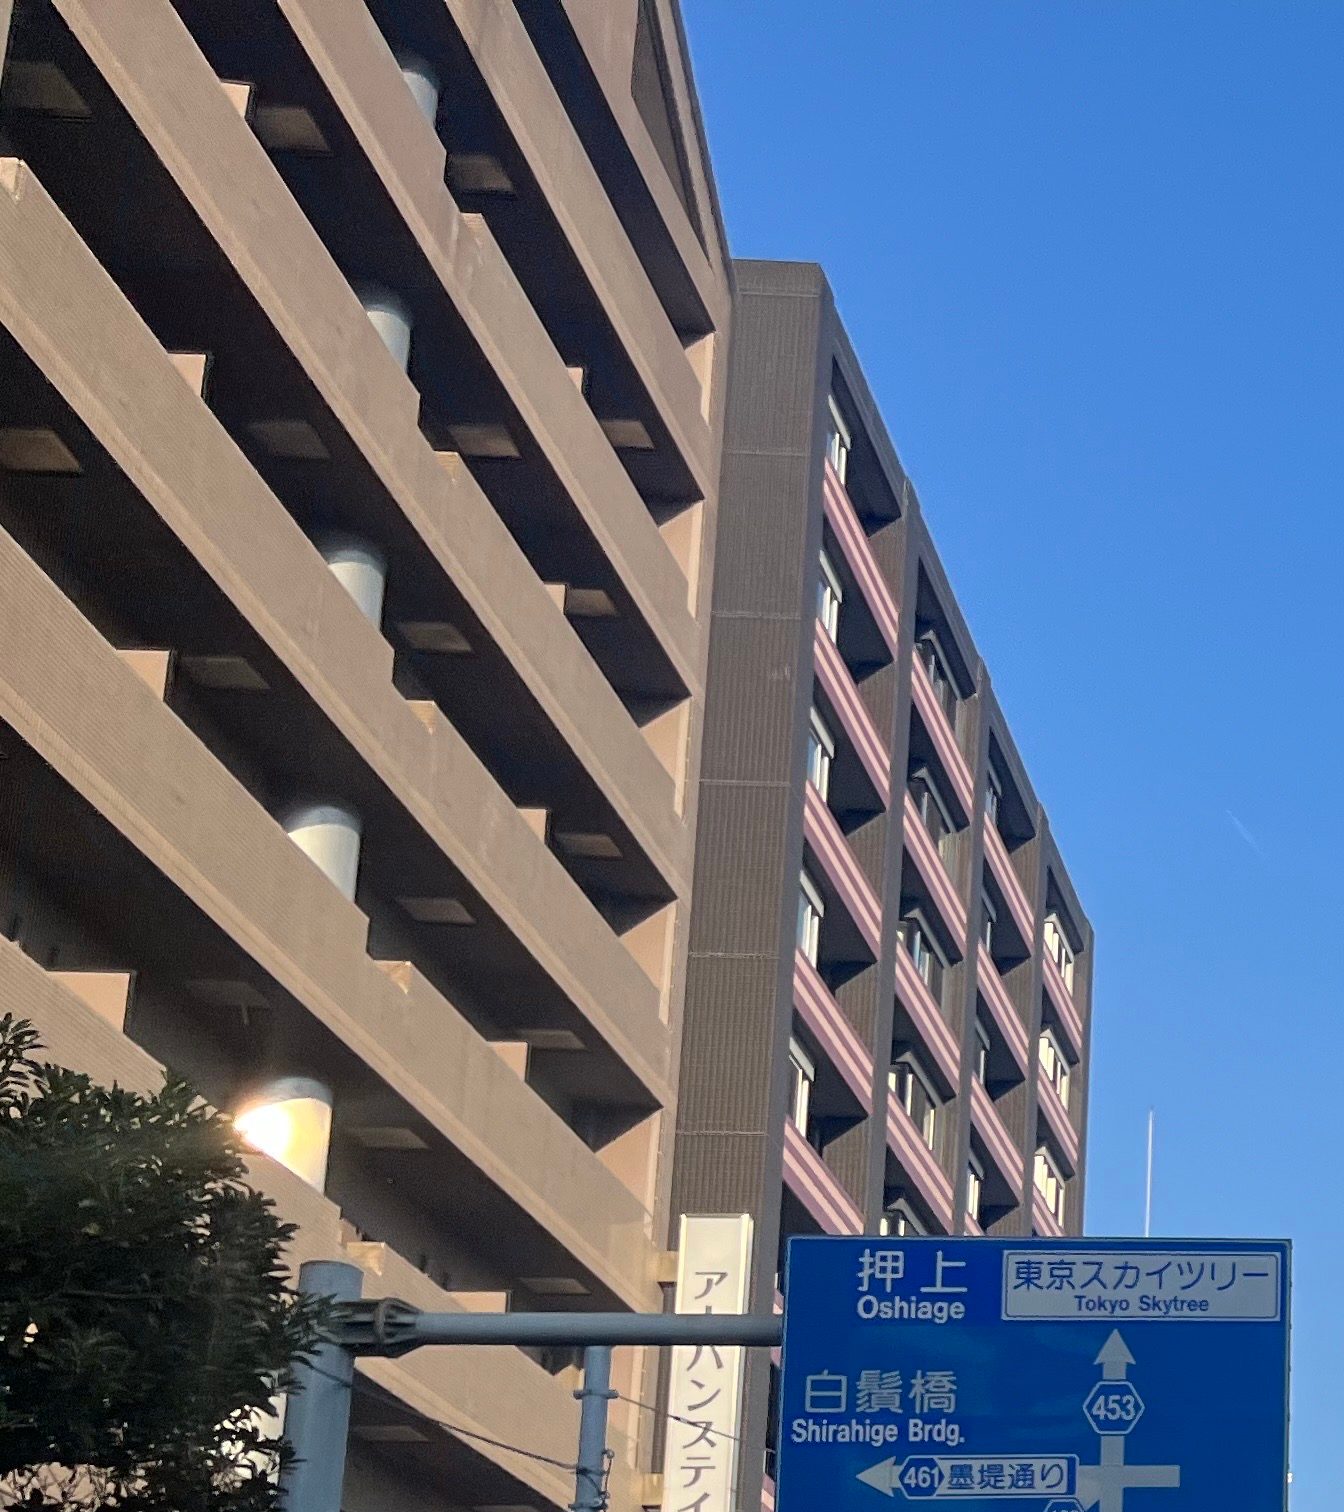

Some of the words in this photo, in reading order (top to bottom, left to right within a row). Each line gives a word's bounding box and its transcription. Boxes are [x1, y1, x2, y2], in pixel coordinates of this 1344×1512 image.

[857, 1248, 968, 1295] 押上
[1012, 1260, 1271, 1292] 東京スカイツリー
[856, 1294, 967, 1324] Oshiage
[1074, 1294, 1130, 1314] Tokyo
[1139, 1295, 1210, 1315] Skytree
[1091, 1395, 1137, 1421] 453
[791, 1418, 898, 1447] Shirahige
[908, 1419, 966, 1447] Brdg.
[904, 1465, 941, 1490] 461
[947, 1462, 1066, 1491] 墨堤通り
